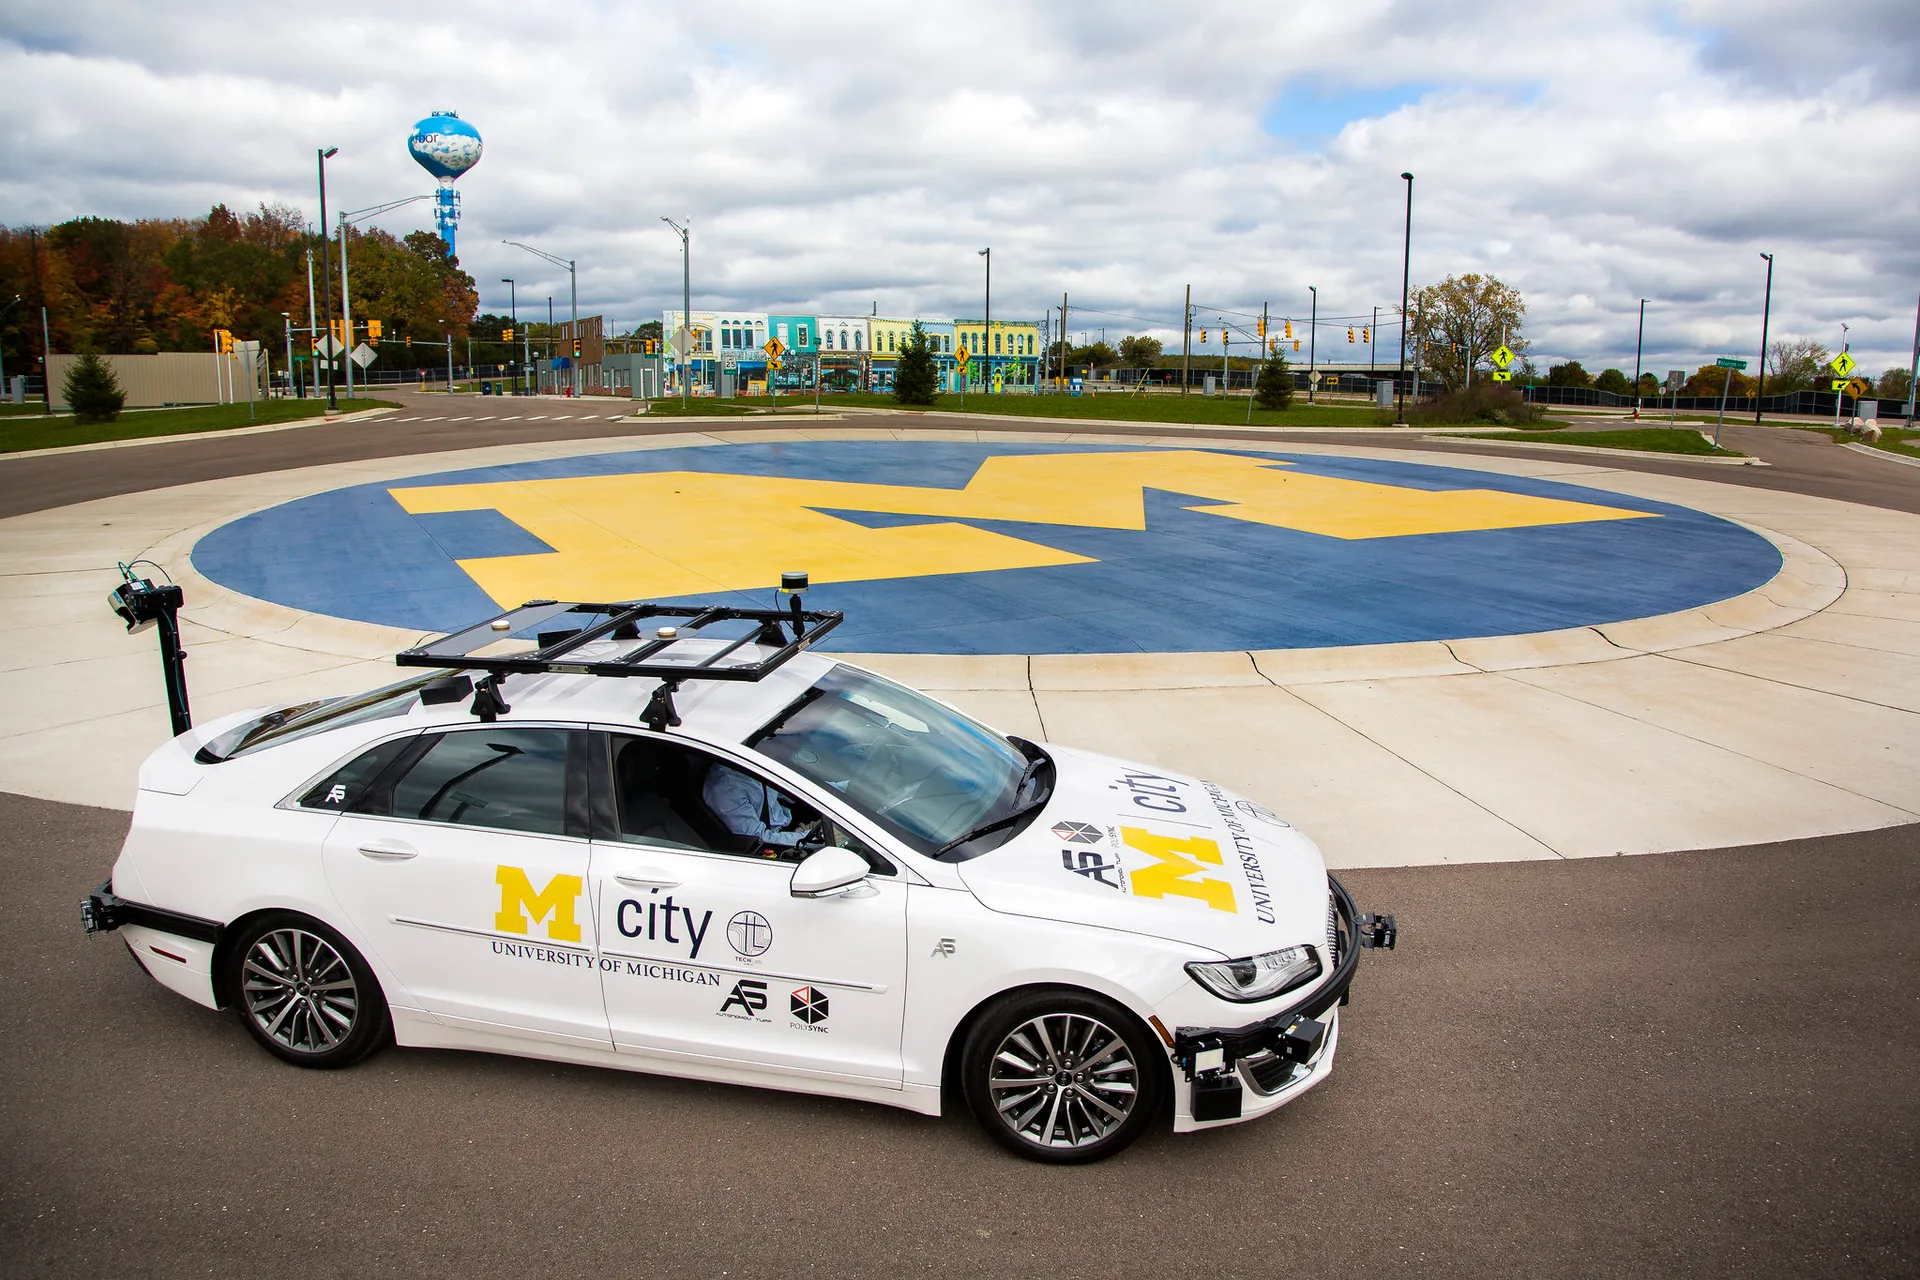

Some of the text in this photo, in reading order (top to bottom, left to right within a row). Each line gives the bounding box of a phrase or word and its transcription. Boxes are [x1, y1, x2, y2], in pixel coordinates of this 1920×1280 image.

[726, 361, 736, 369] 25
[1109, 767, 1190, 813] city
[1223, 818, 1246, 832] OF
[1120, 826, 1238, 914] M
[1231, 832, 1276, 925] UNIVERSITY
[495, 865, 713, 958] M city
[492, 942, 721, 986] UNIVERSITY OF MICHIGAN
[789, 1021, 829, 1034] POLYSYNC
